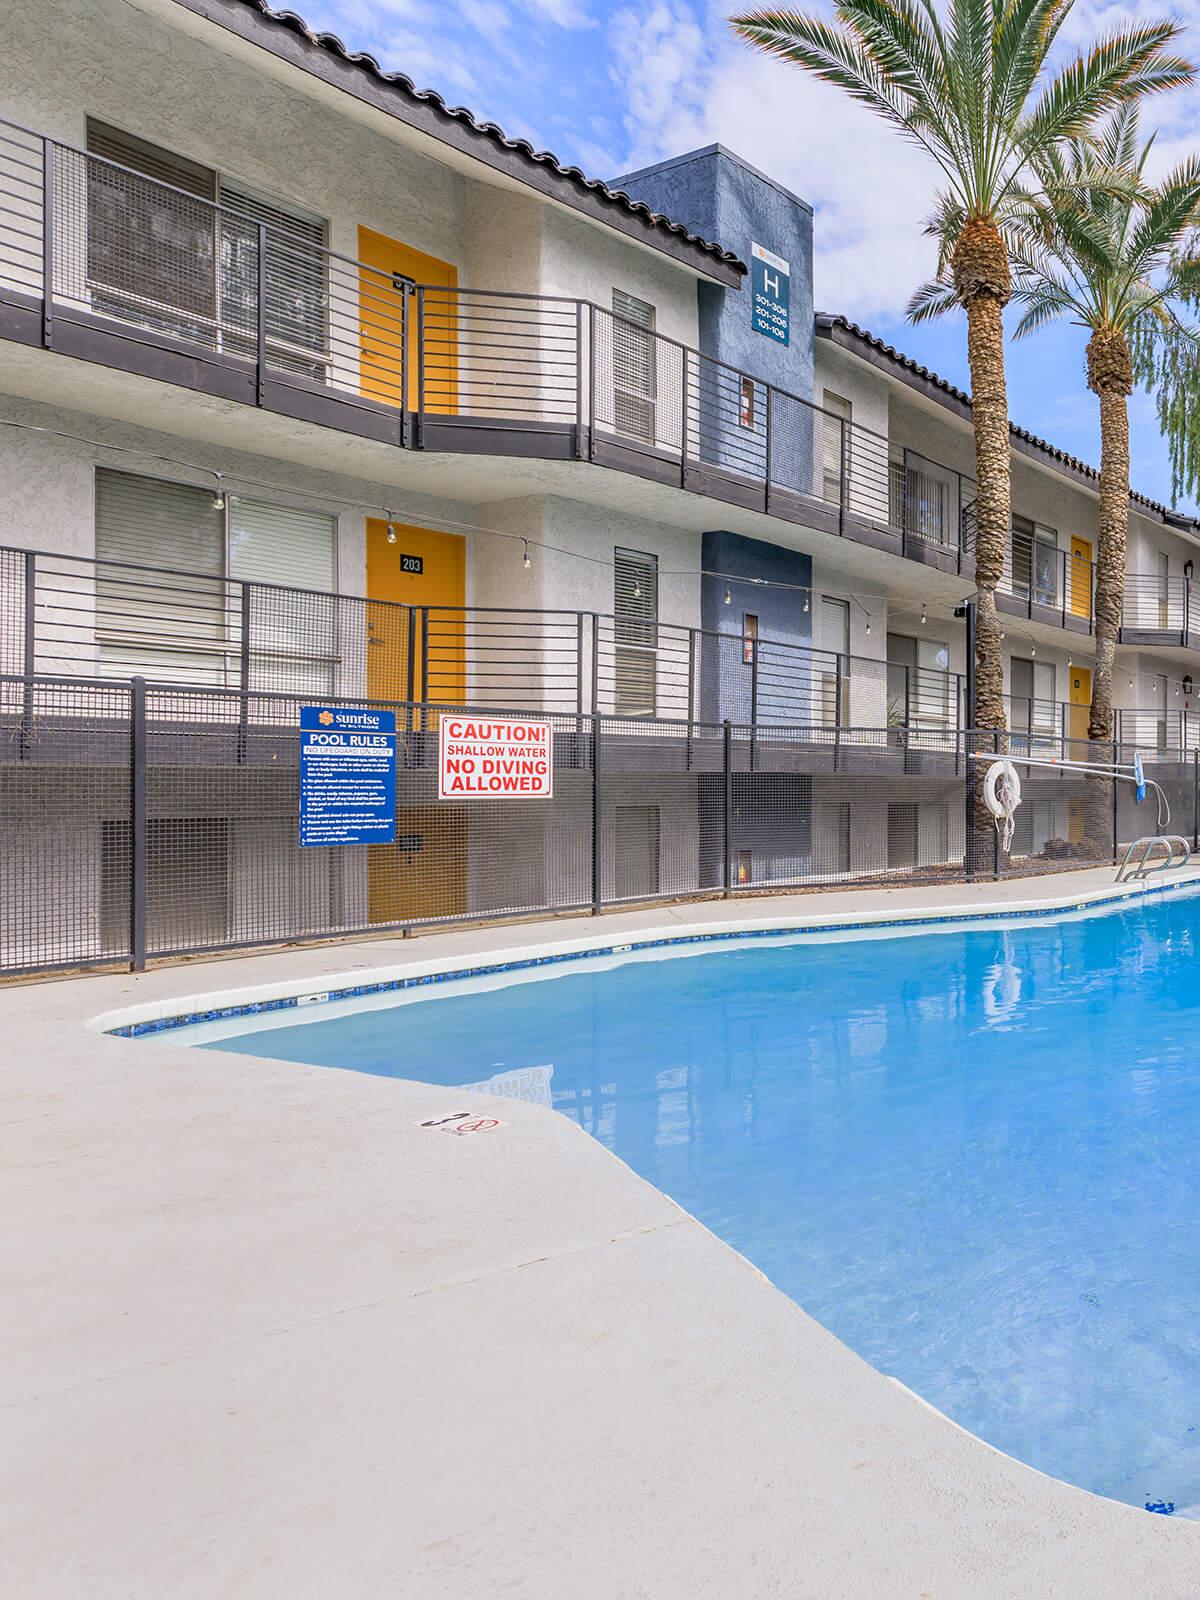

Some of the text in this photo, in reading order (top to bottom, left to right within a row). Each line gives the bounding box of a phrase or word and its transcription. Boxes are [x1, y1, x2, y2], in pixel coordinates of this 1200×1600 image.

[764, 269, 778, 298] H
[403, 558, 421, 572] 203
[336, 713, 380, 725] sunrise
[448, 722, 546, 742] CAUTION!
[310, 734, 388, 747] POOL RULES
[447, 744, 546, 758] SHALLOW WATER
[446, 759, 547, 775] NO DIVING
[450, 776, 543, 791] ALLOWED
